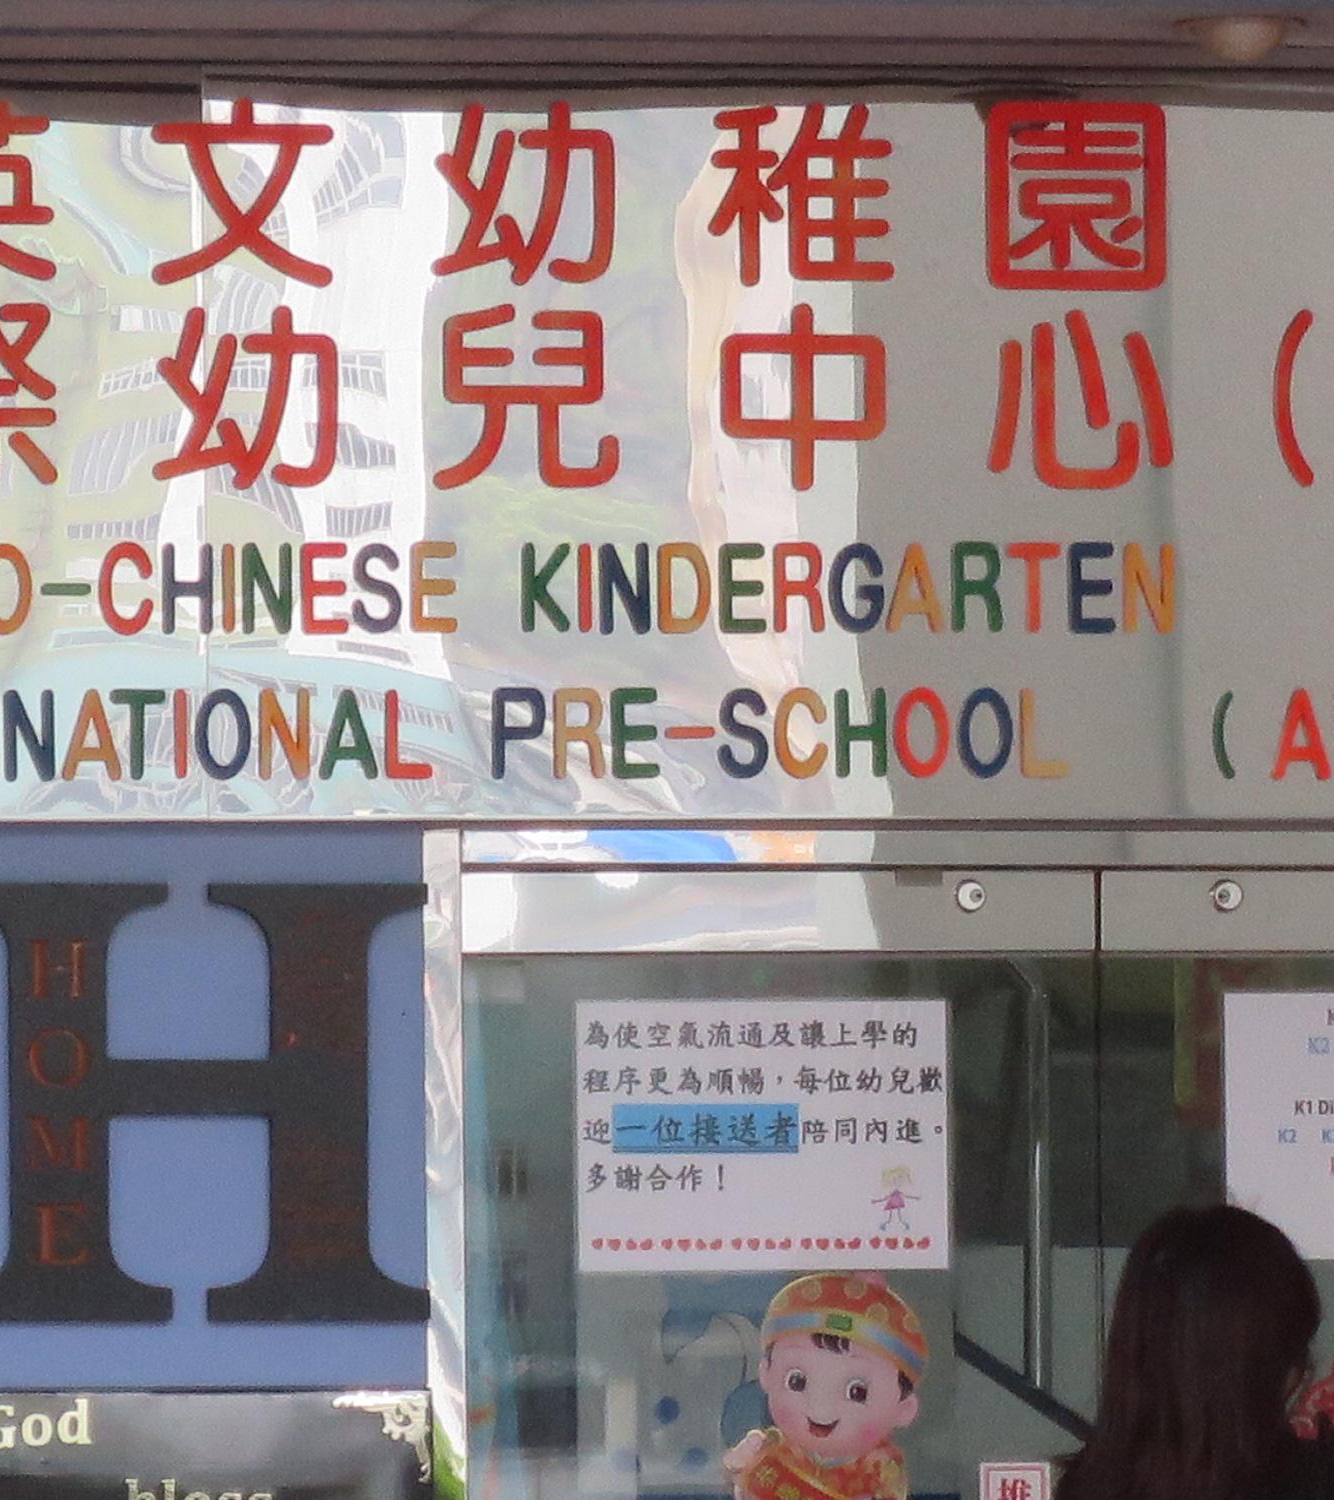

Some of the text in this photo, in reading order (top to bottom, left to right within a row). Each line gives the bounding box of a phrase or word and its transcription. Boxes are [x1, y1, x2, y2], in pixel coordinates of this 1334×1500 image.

[521, 540, 1176, 635] KINDERGARTEN
[491, 686, 1067, 781] PRE-SCHOOL
[583, 1019, 919, 1050] 為使空氣流通及讓上學的
[25, 938, 94, 1268] HOME
[1294, 1100, 1313, 1116] K1
[1277, 1128, 1298, 1144] K2
[585, 1162, 725, 1194] 多謝合作！
